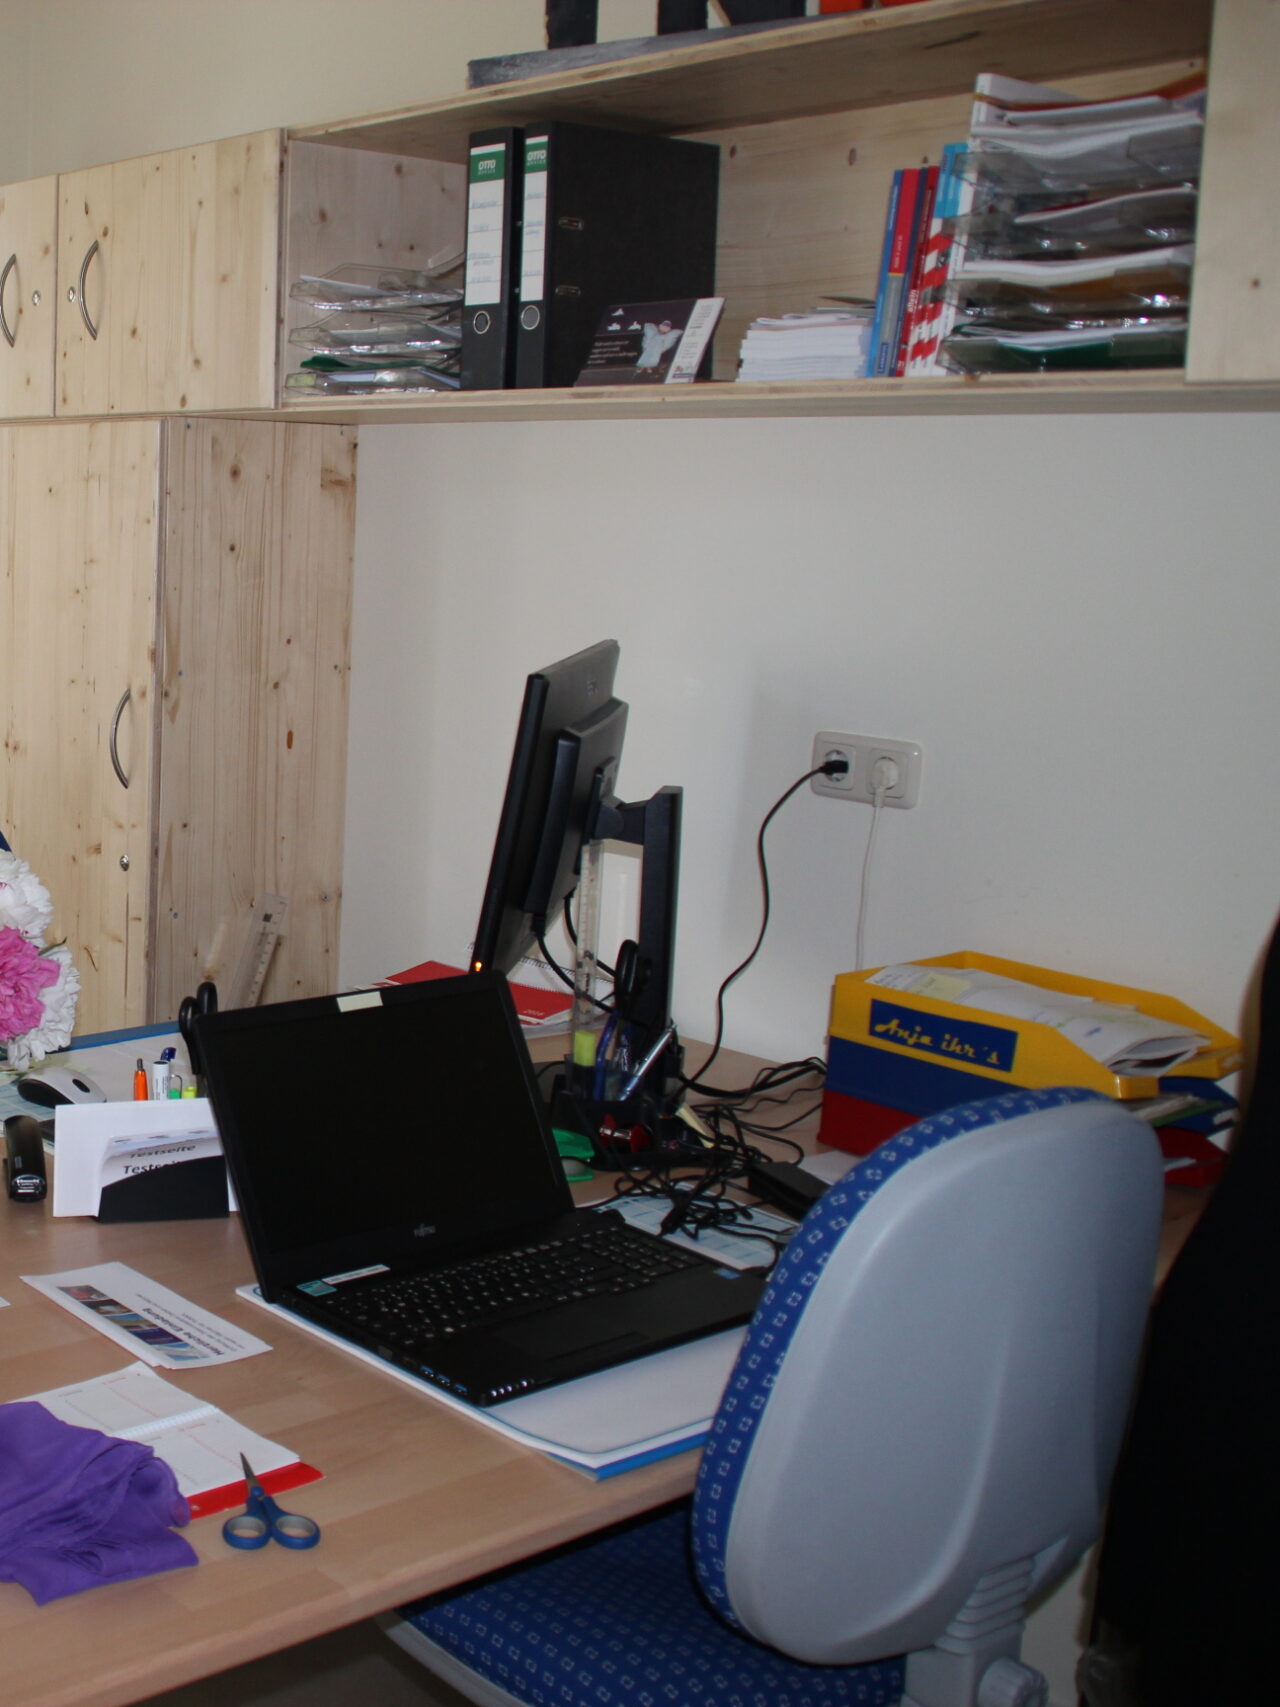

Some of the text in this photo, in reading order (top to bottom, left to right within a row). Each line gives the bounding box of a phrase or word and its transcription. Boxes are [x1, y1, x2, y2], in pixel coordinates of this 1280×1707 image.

[527, 150, 546, 161] OTTO
[478, 159, 496, 170] OTTO
[874, 1018, 934, 1045] Anja
[941, 1033, 976, 1058] ihr
[130, 1145, 196, 1158] Testseite
